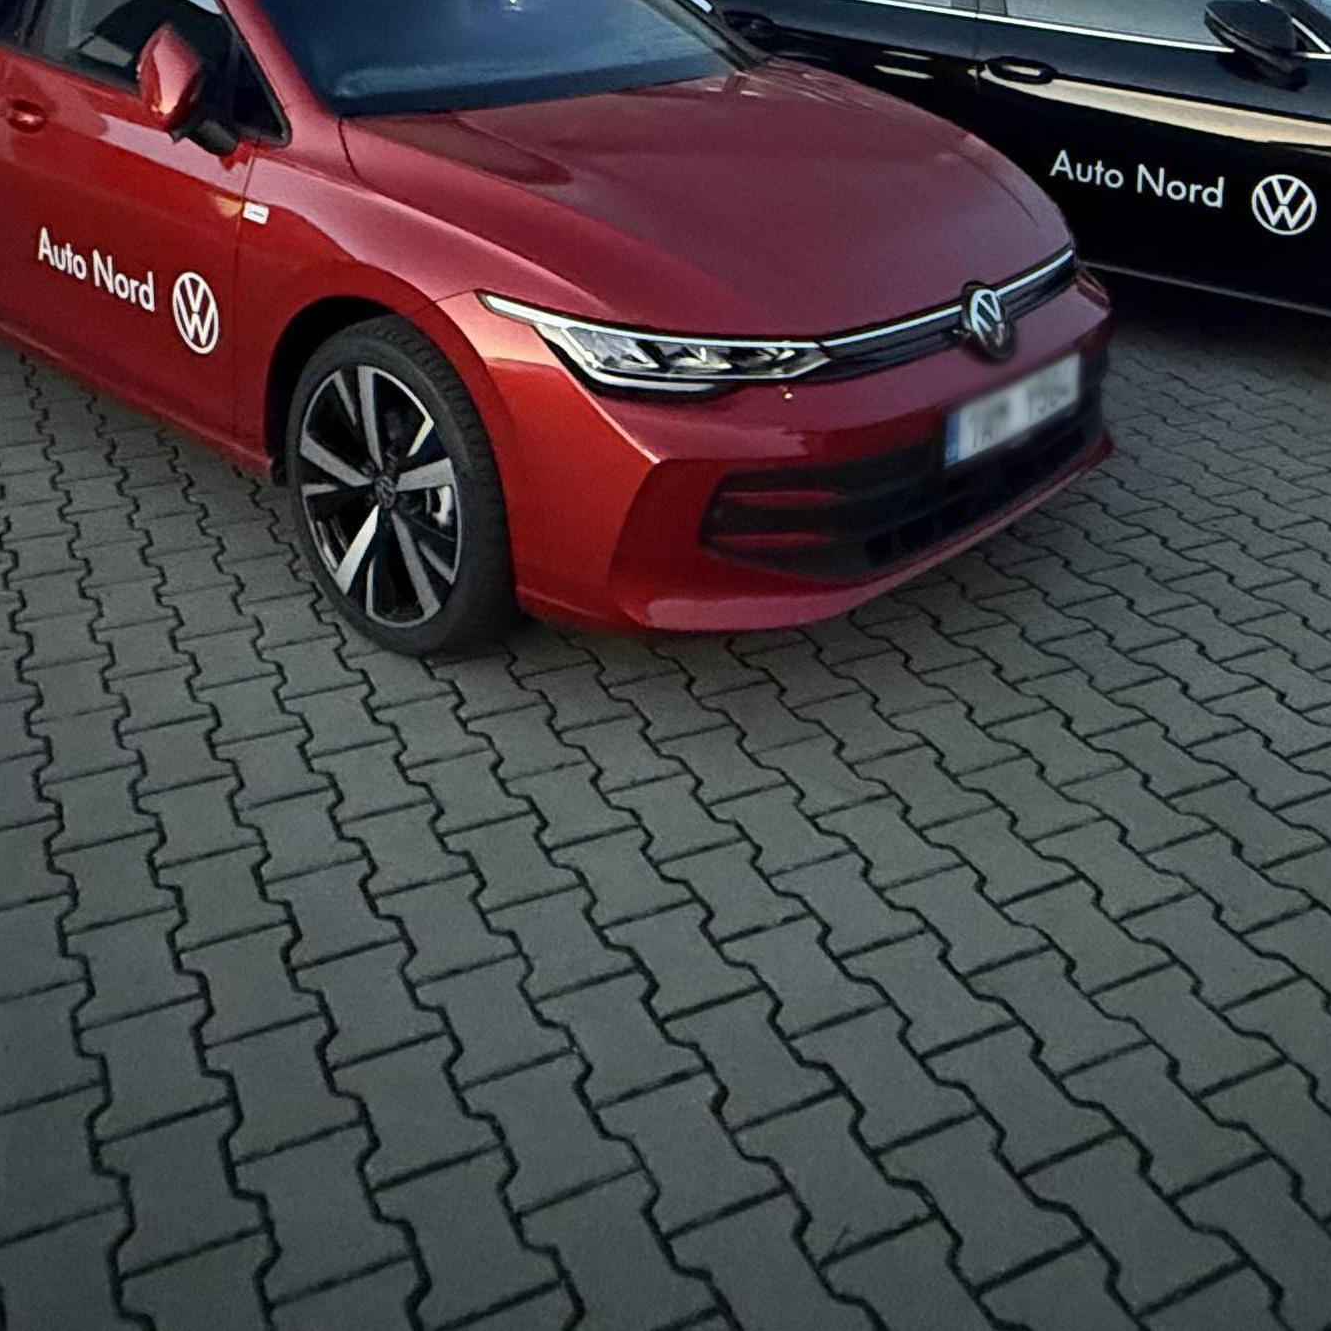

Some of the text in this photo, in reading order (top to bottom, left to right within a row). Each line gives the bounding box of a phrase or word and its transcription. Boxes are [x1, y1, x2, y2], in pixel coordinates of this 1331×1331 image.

[1049, 149, 1124, 189] Auto
[1136, 163, 1225, 209] Nord
[38, 227, 87, 281] Auto
[92, 249, 156, 312] Nord
